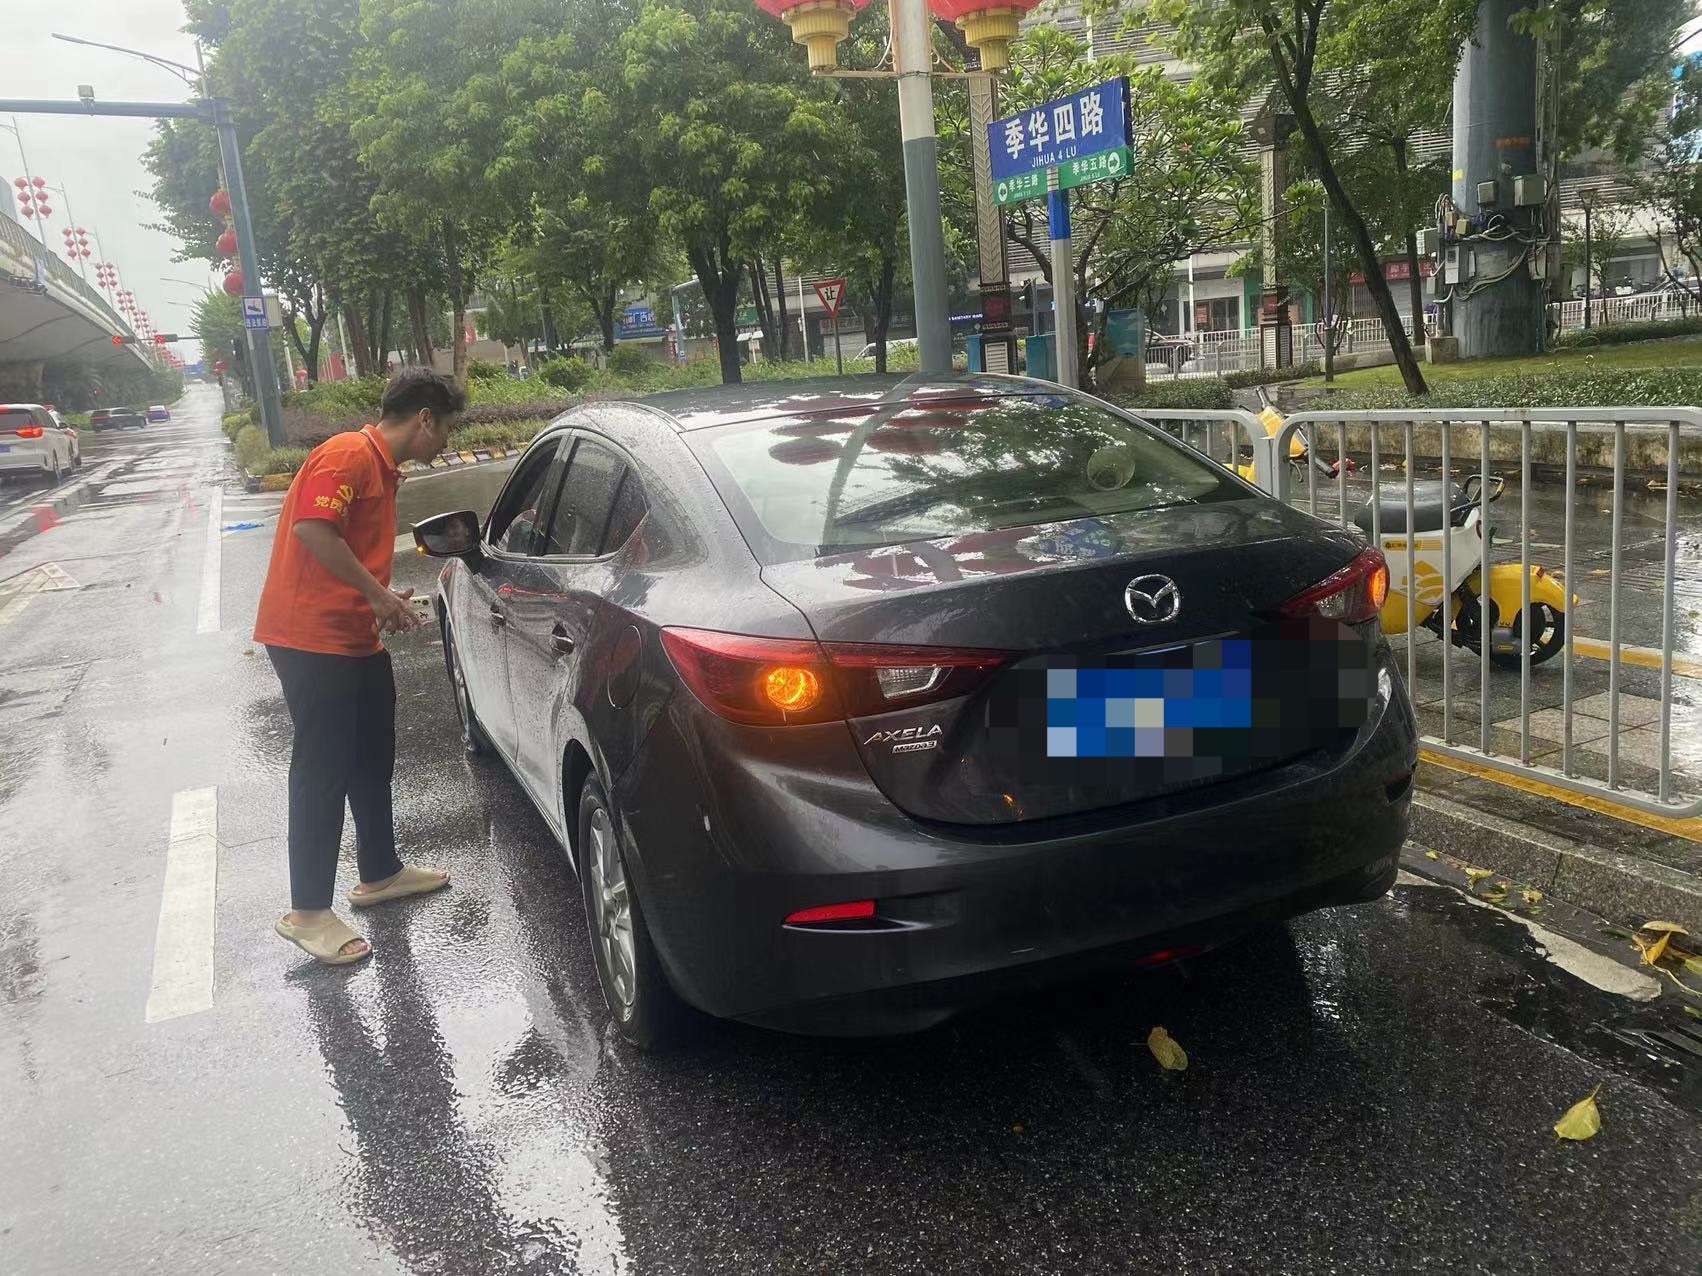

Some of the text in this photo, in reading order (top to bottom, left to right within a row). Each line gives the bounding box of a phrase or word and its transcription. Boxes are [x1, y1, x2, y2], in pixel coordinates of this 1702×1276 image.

[1005, 92, 1103, 159] 季华四路
[1031, 145, 1077, 168] JIHUA 4 LU
[1072, 154, 1107, 176] 季华五路
[1009, 173, 1039, 192] 季华三路
[825, 286, 837, 301] 让
[864, 724, 943, 745] AXELA
